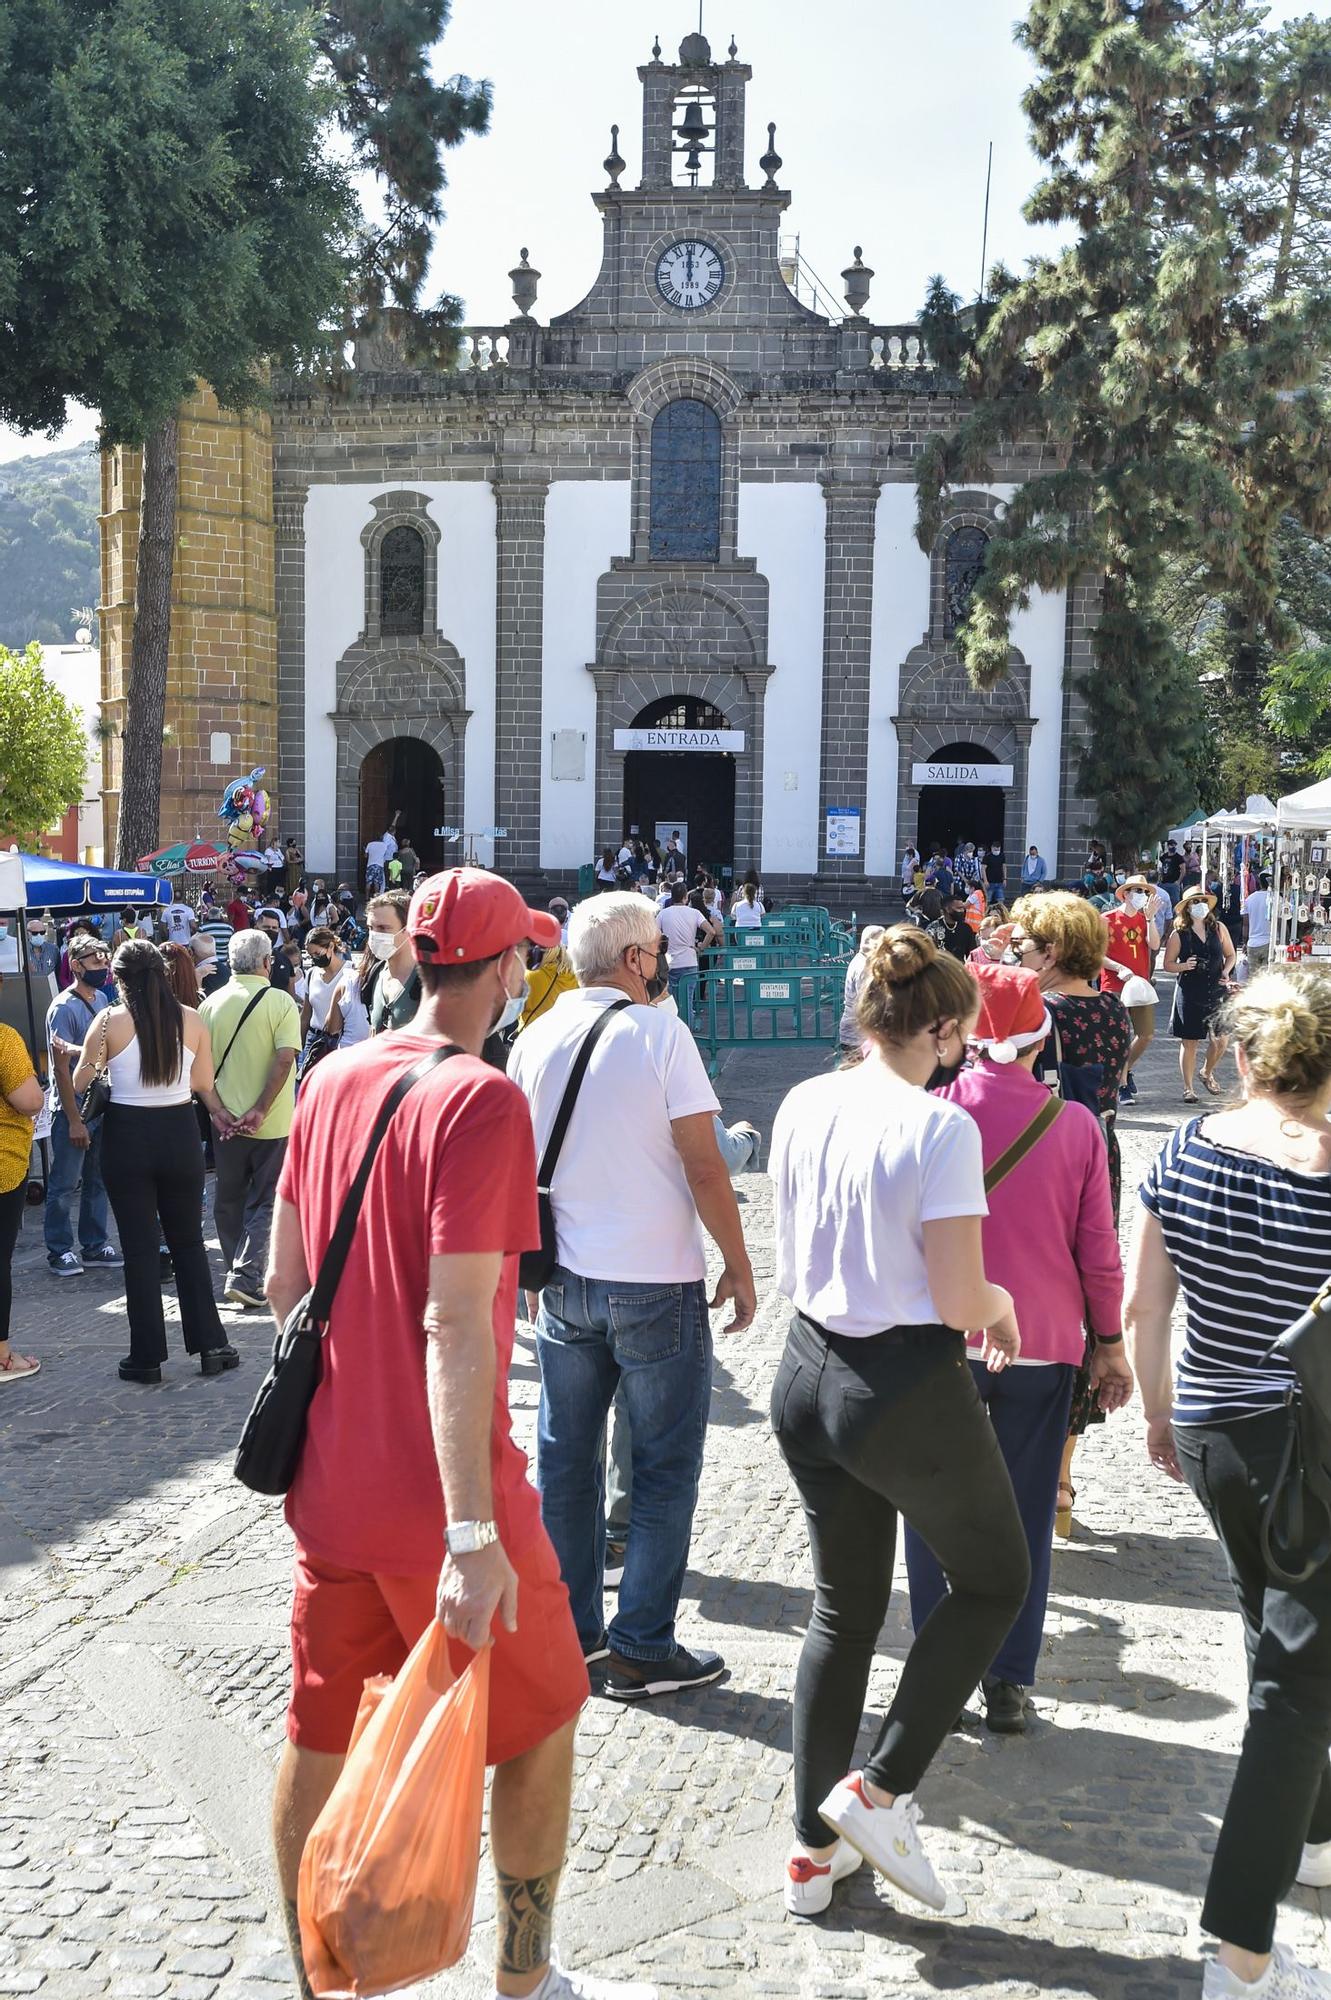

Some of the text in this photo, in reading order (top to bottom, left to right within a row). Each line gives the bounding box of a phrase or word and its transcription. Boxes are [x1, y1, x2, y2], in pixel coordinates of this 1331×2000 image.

[681, 281, 699, 289] 1989
[647, 732, 720, 745] ENTRADA
[927, 766, 979, 779] SALIDA
[1129, 944, 1137, 959] 7
